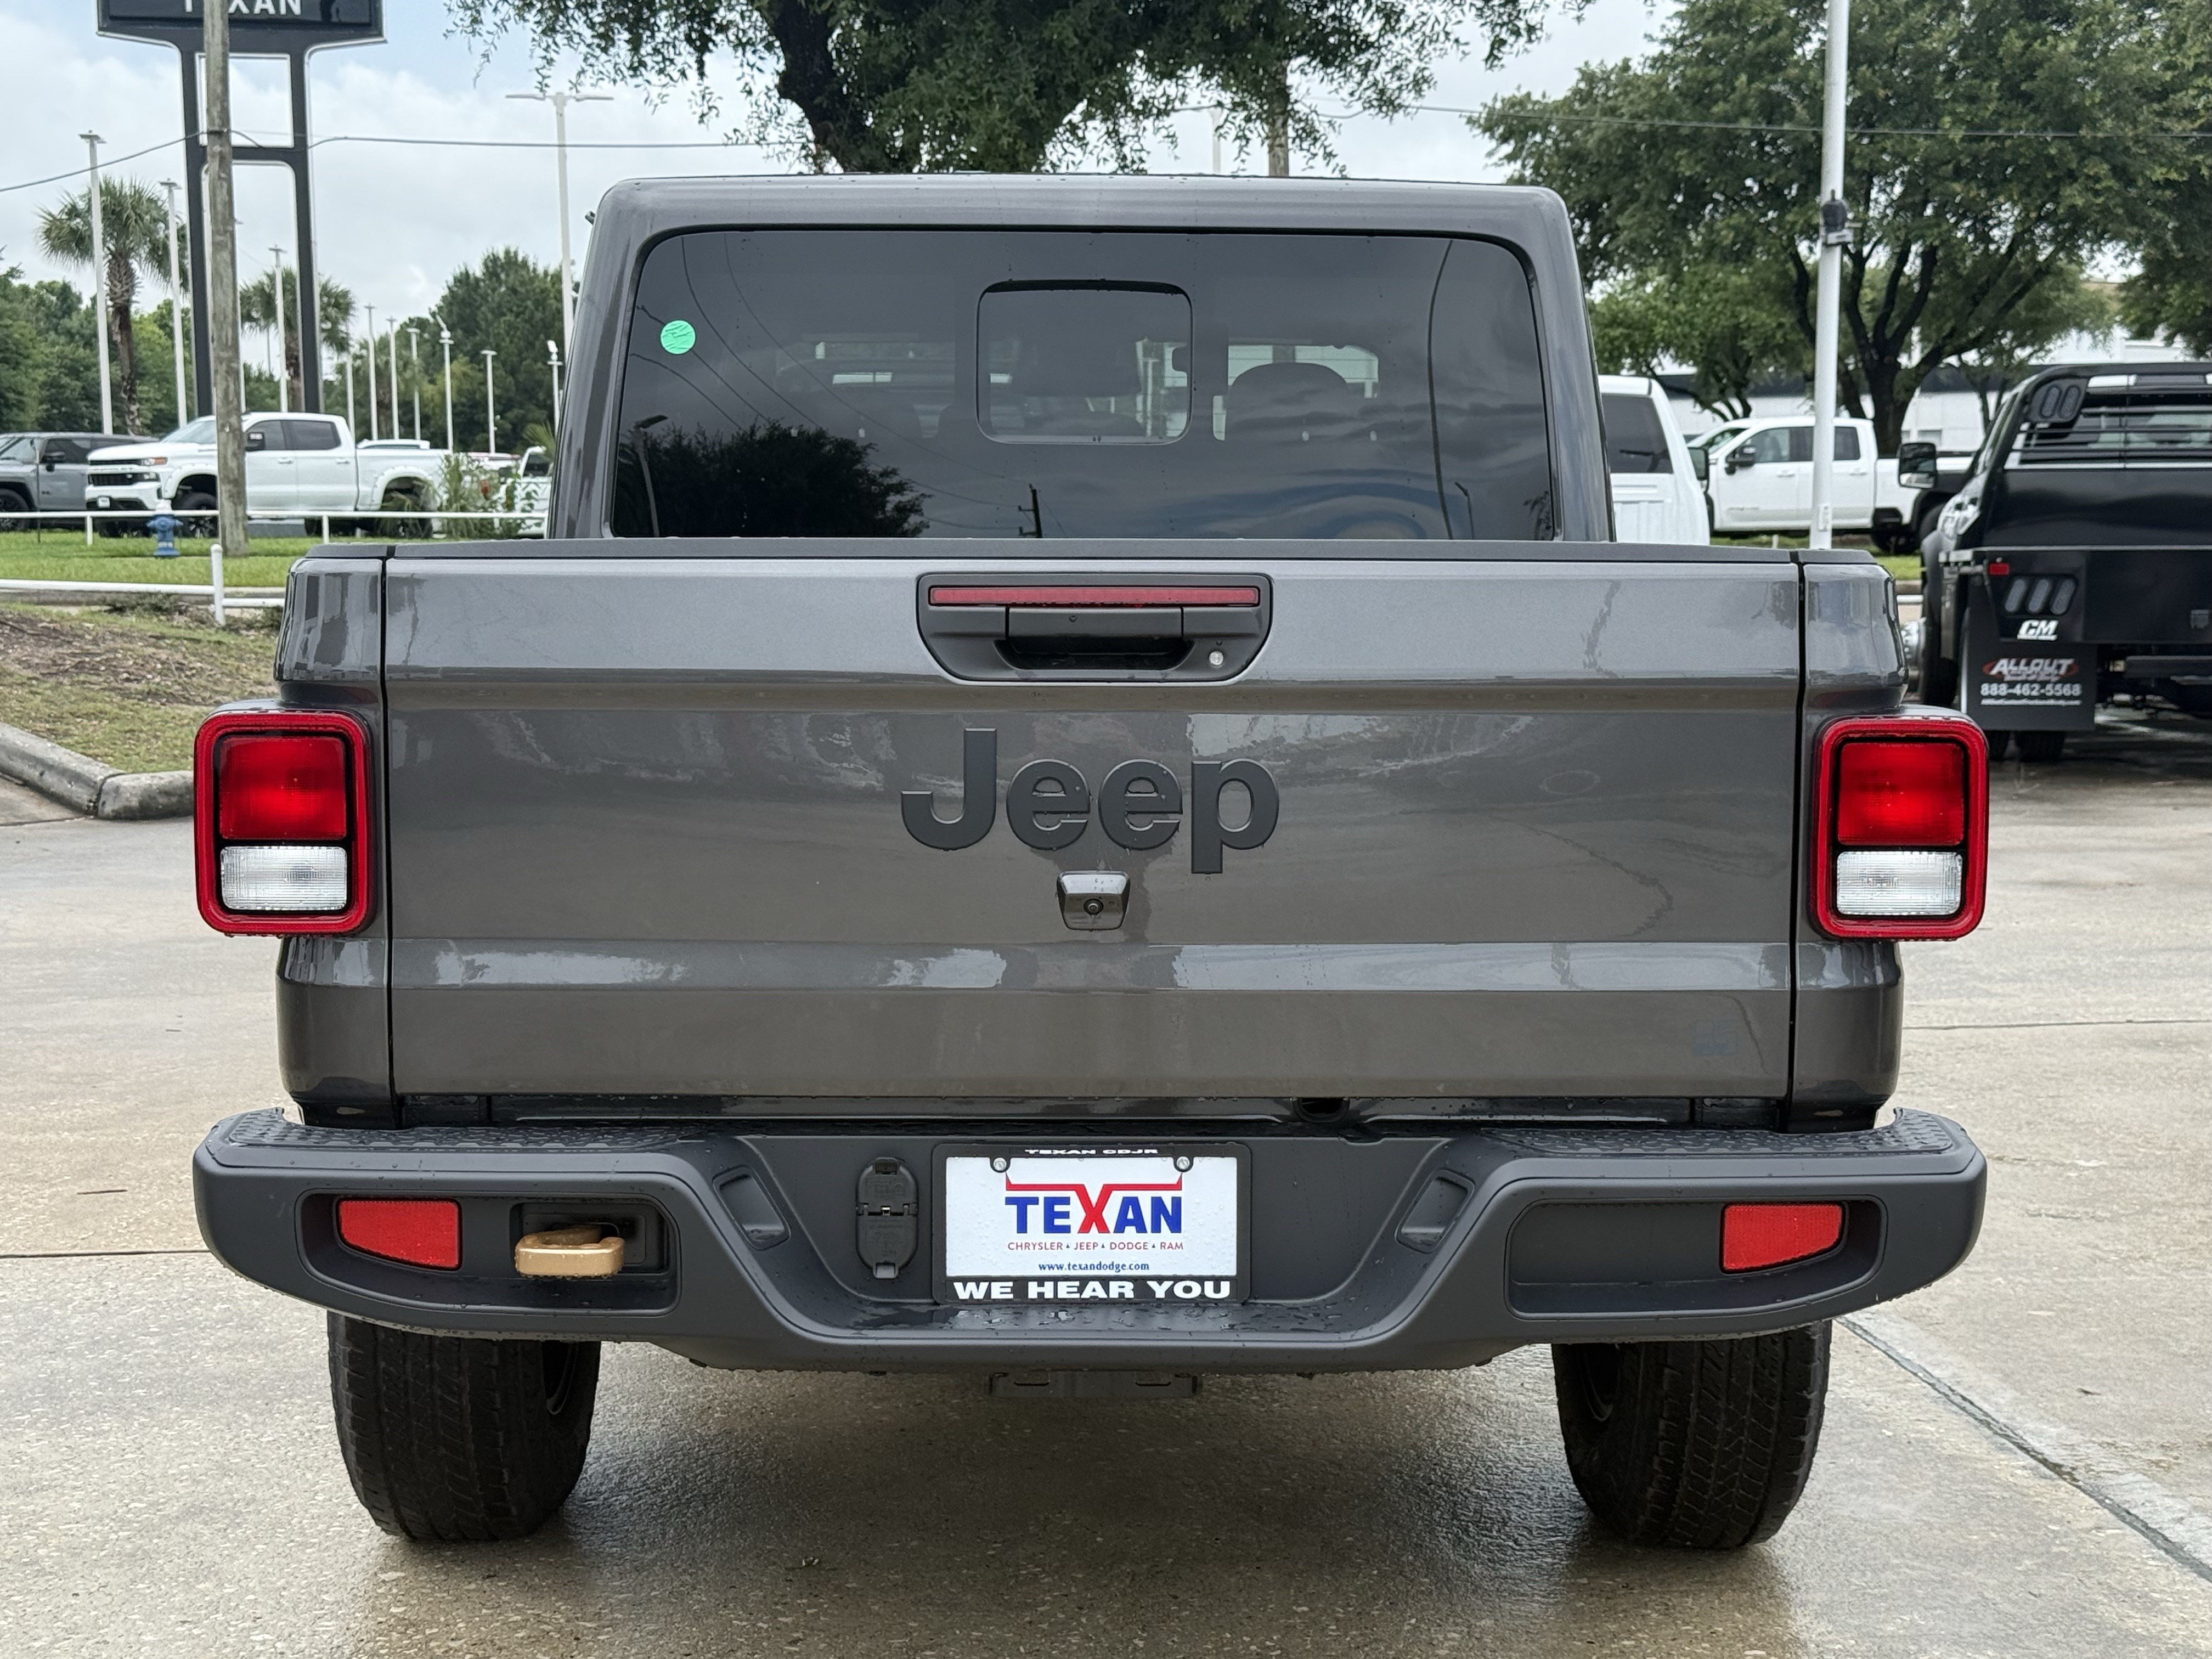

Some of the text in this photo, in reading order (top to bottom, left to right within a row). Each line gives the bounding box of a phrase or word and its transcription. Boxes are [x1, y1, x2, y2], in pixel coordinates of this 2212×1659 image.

[901, 727, 1279, 874] Jeep
[1005, 1183, 1182, 1234] TEXAN
[1007, 1242, 1184, 1251] CHRYSLER JEEP DODGE RAM
[1038, 1261, 1150, 1273] www.texandodge.com
[953, 1280, 1231, 1300] WE HEAR YOU
